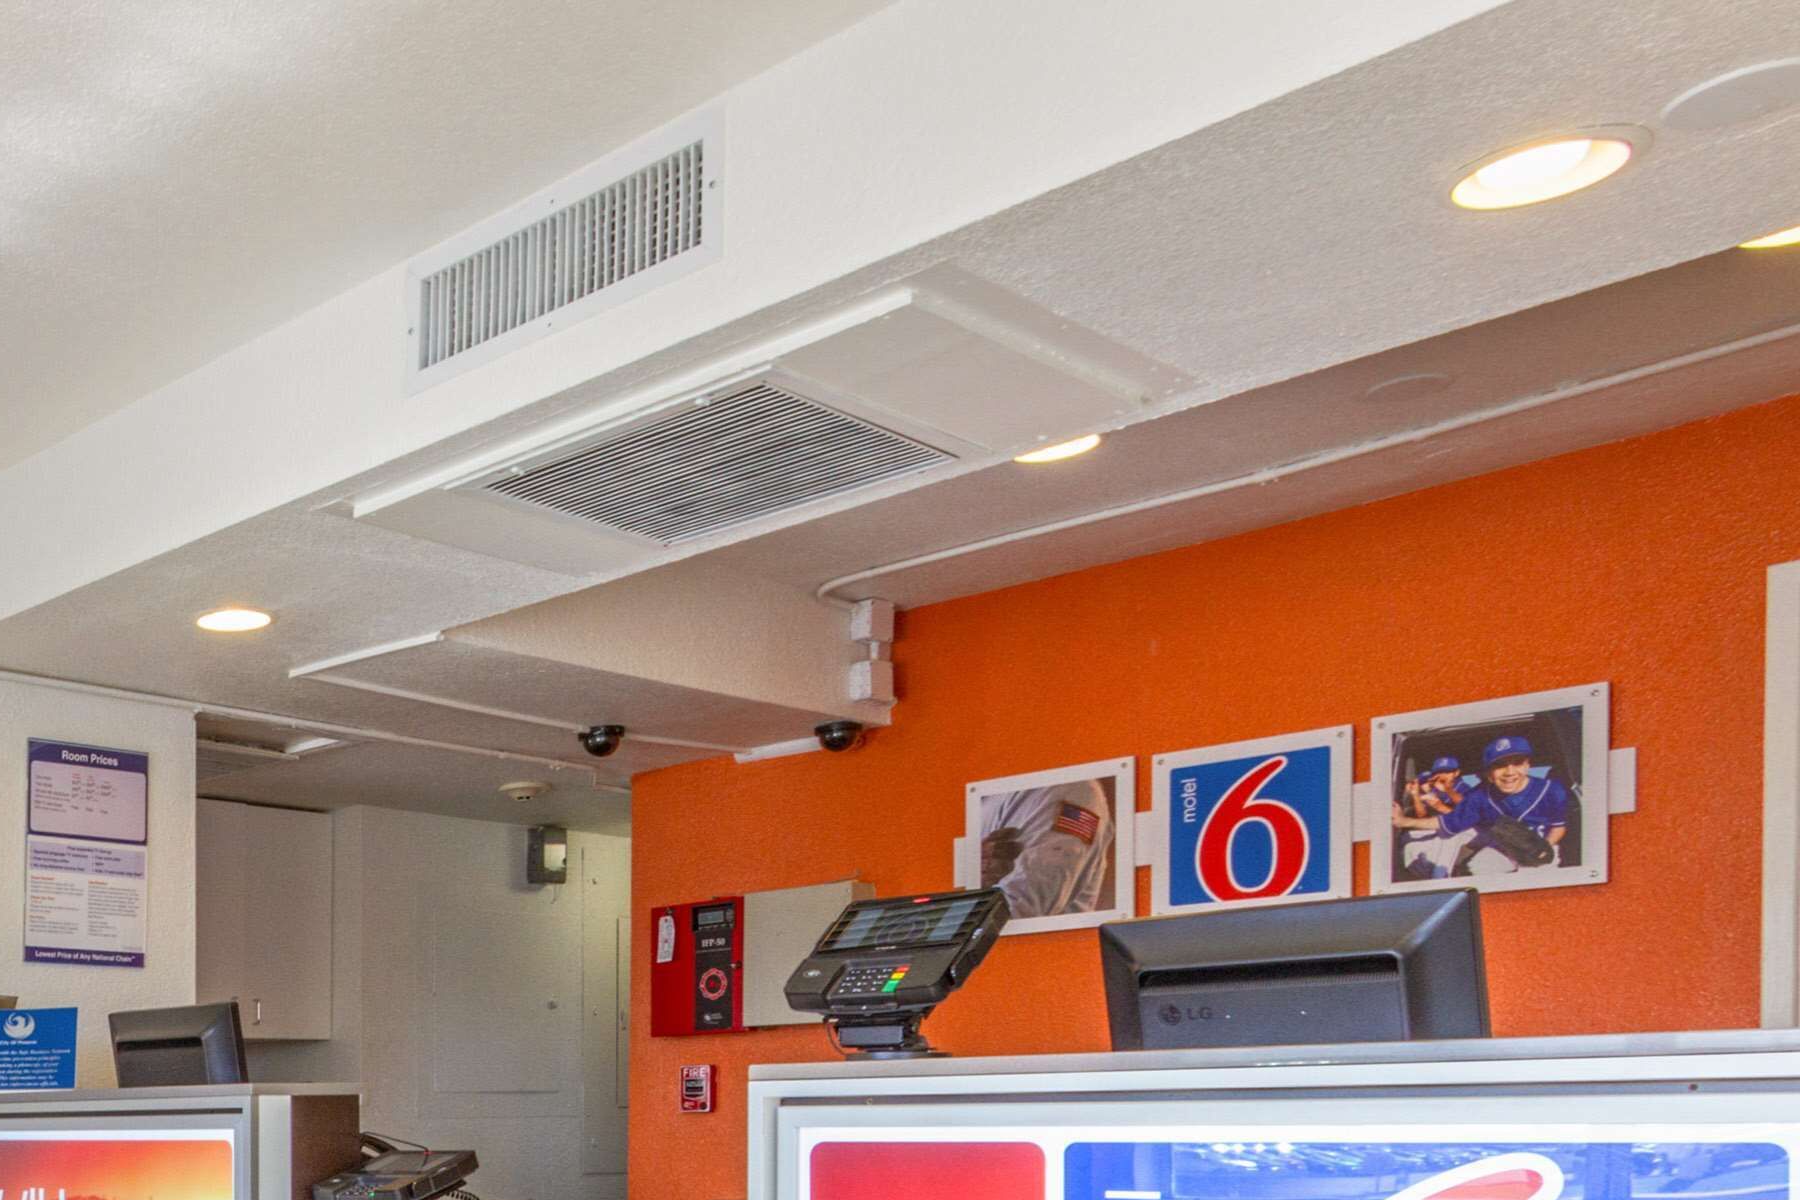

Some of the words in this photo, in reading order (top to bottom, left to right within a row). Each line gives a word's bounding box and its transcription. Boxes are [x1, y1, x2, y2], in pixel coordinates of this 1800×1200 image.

[61, 749, 88, 762] Room
[90, 753, 119, 767] Prices
[1180, 777, 1197, 823] motel
[1194, 755, 1310, 903] 6
[57, 951, 72, 960] Price
[79, 953, 91, 962] Any
[1186, 1007, 1213, 1020] LG
[683, 1067, 706, 1078] FIRE
